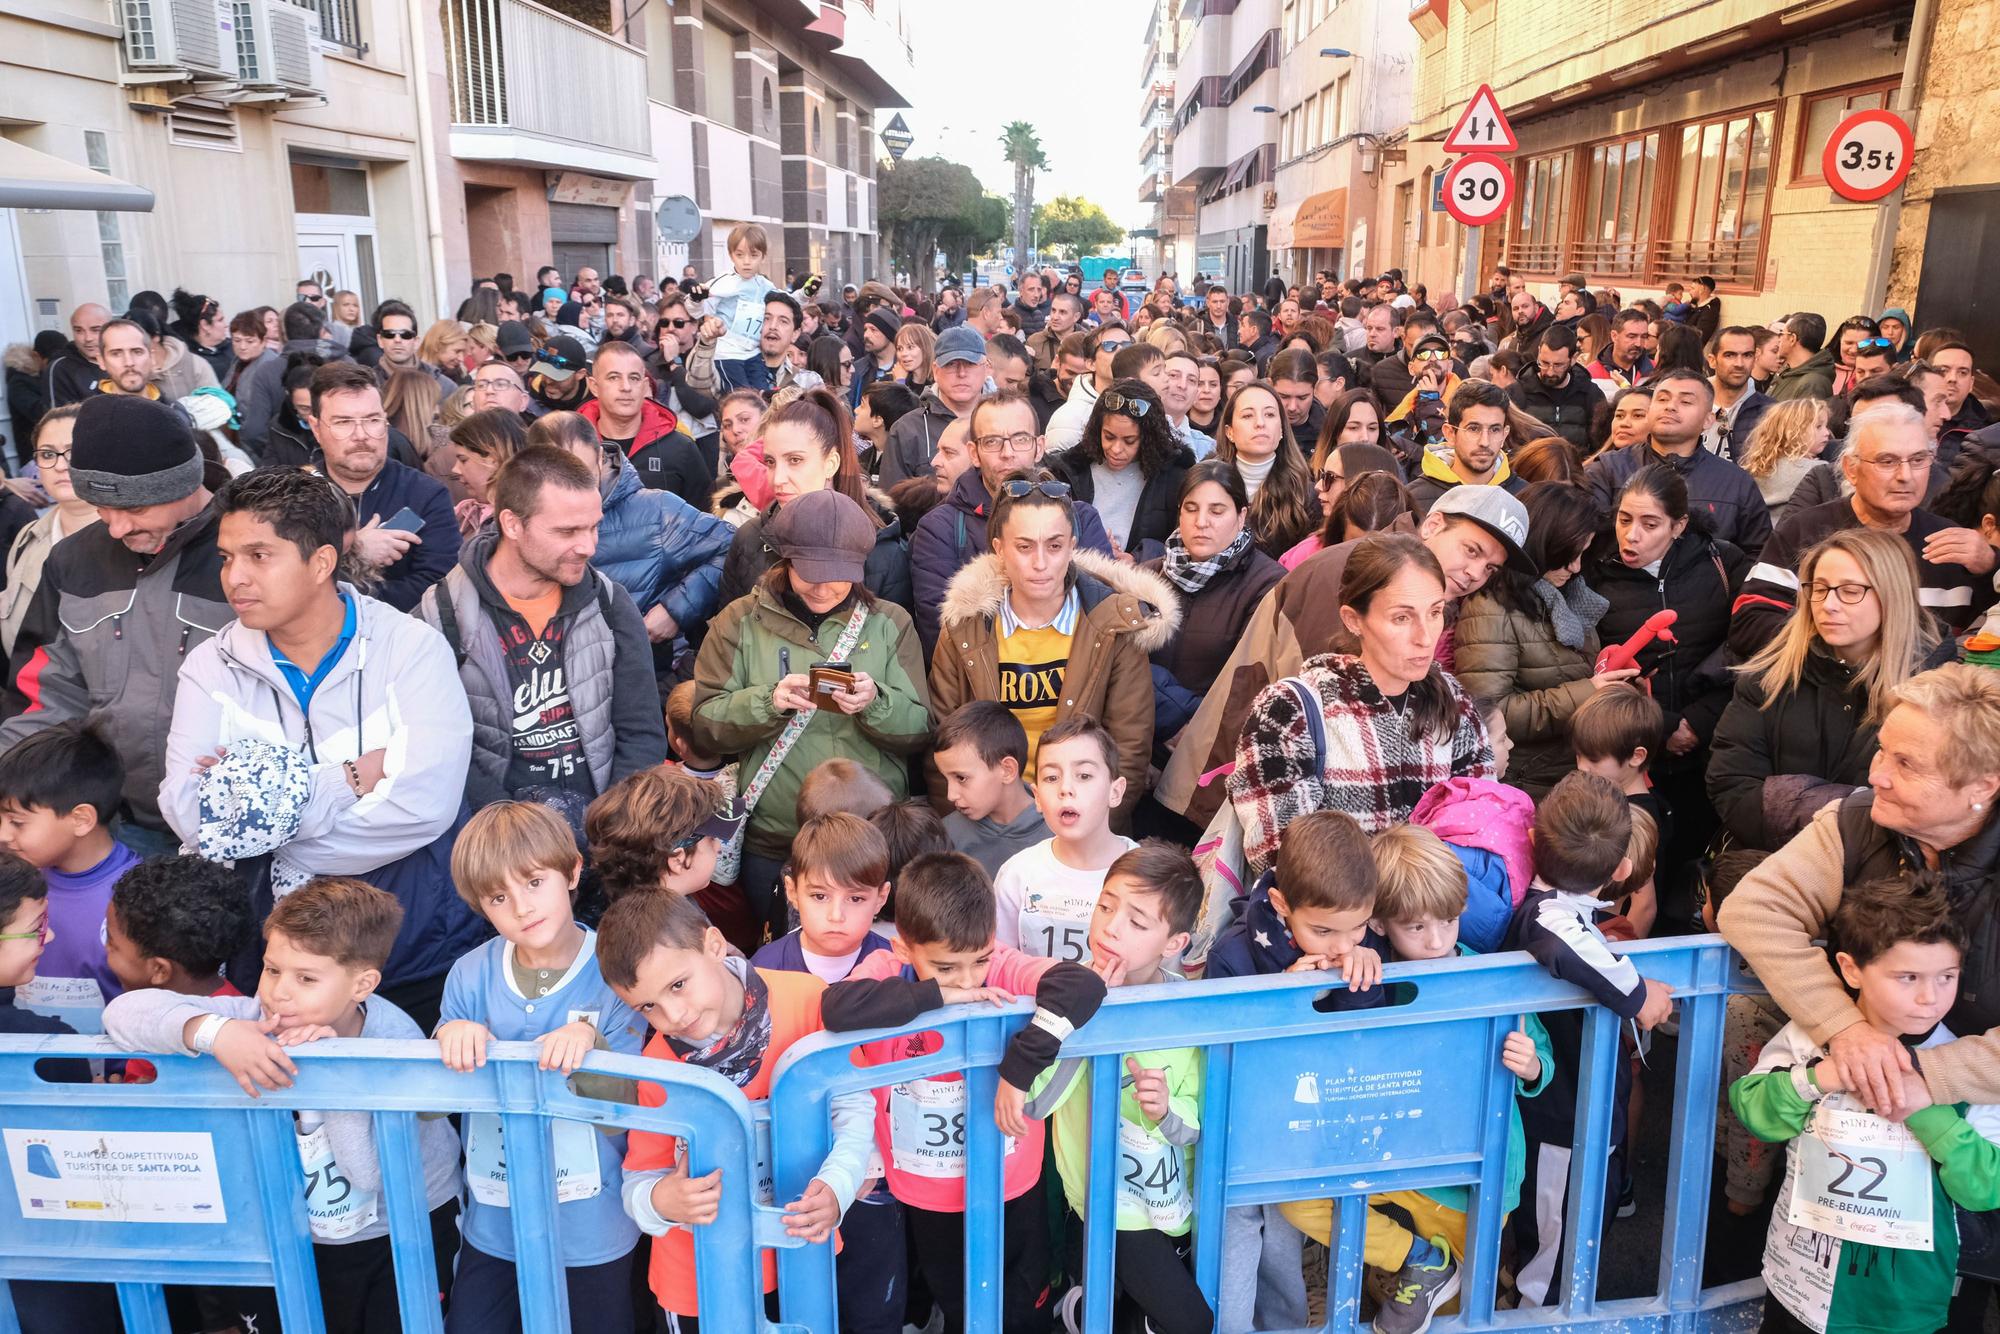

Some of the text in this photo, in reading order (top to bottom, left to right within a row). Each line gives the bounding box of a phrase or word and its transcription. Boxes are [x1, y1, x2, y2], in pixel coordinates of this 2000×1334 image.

[1459, 178, 1499, 201] 30
[547, 754, 575, 779] 75
[1041, 926, 1091, 963] 15
[1360, 1069, 1422, 1082] COMPETITIVIDAD
[1378, 1081, 1401, 1090] SANTA
[1402, 1079, 1421, 1087] POLA
[1841, 1119, 1868, 1129] MINI
[64, 1150, 91, 1159] PLAN
[111, 1151, 199, 1161] COMPETITIVIDAD
[916, 1148, 965, 1158] PRE-BENJ
[65, 1161, 201, 1173] TURÍSTICA DE SANTA POLA
[1122, 1145, 1180, 1195] 244
[1827, 1152, 1888, 1202] 22
[1818, 1196, 1902, 1219] PRE-BENJAMÍN
